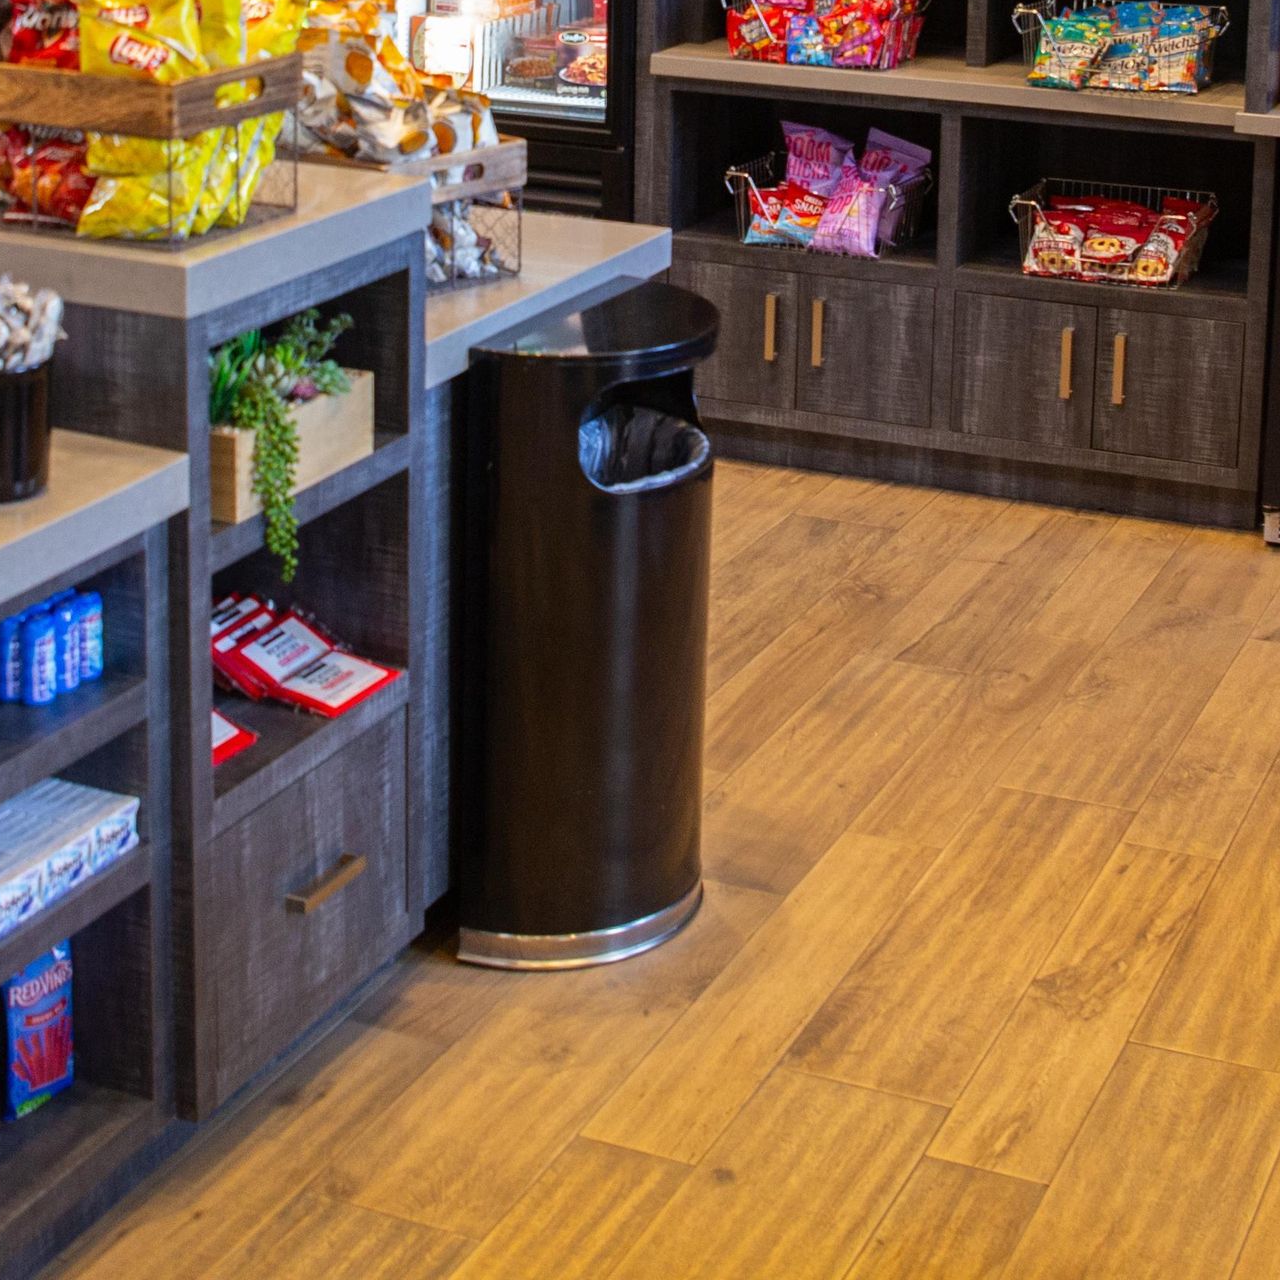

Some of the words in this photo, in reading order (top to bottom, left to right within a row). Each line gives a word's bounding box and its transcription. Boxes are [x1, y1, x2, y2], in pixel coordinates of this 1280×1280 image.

[111, 33, 169, 70] Lay's
[1152, 36, 1198, 54] Welch's
[794, 198, 824, 216] SNAP
